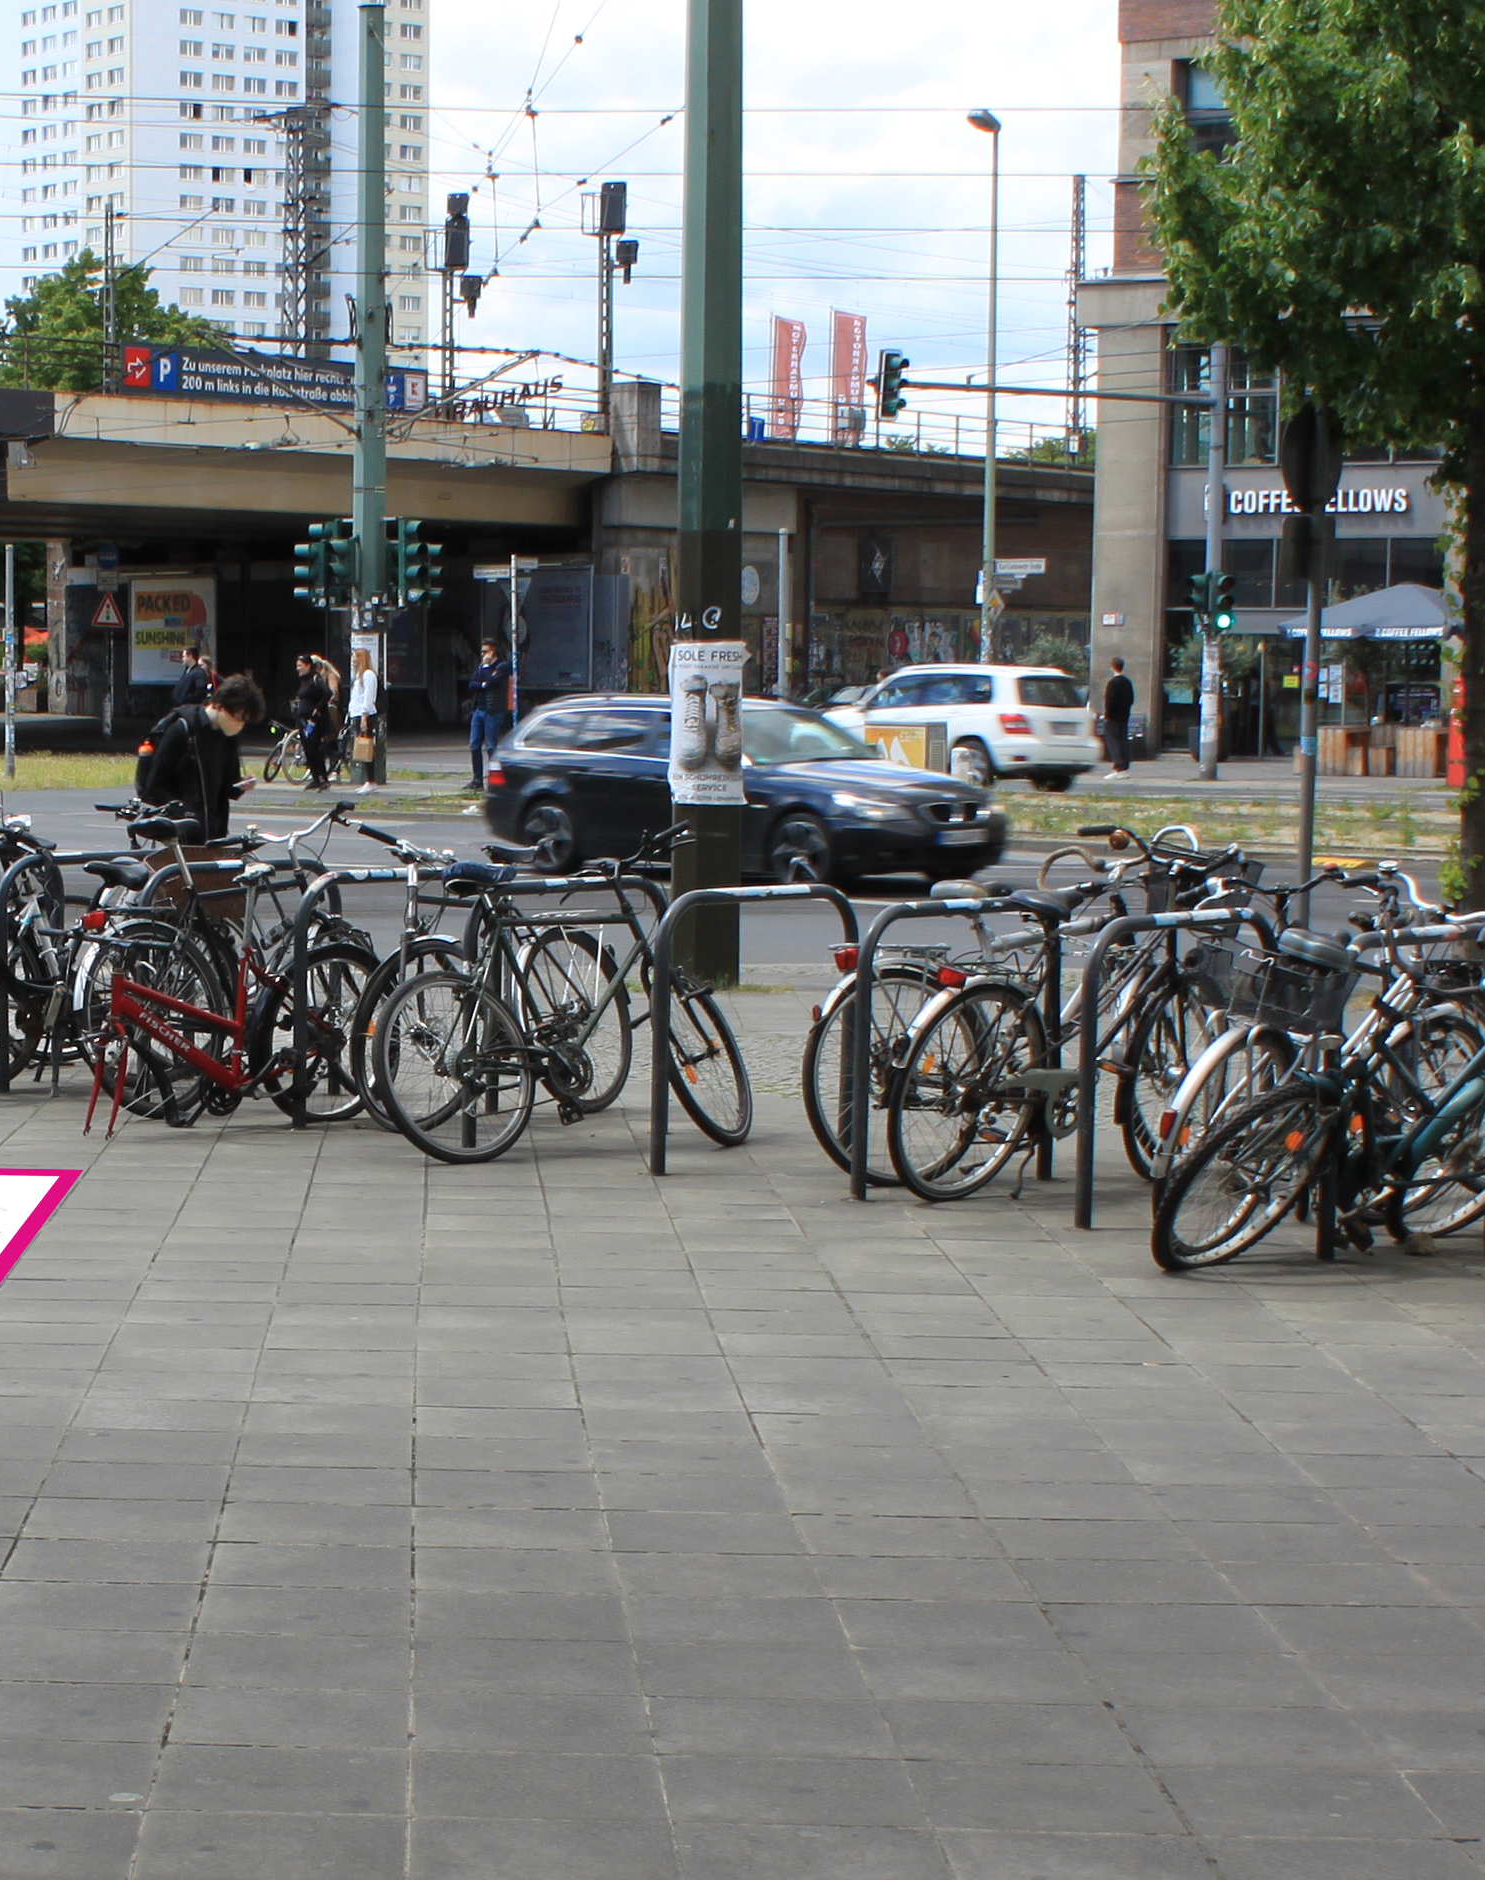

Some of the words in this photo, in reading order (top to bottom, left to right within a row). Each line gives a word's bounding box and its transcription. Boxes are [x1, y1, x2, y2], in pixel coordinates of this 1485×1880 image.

[182, 357, 196, 371] Zu
[199, 363, 242, 376] unserem
[294, 367, 312, 382] hier
[182, 375, 202, 390] 200
[204, 381, 215, 392] m
[217, 378, 240, 394] links
[242, 381, 252, 394] in
[254, 381, 270, 396] die
[136, 593, 191, 611] PACKED
[136, 631, 186, 645] SUNSHINE
[678, 650, 705, 661] SOLE
[139, 1012, 191, 1052] FISCHER
